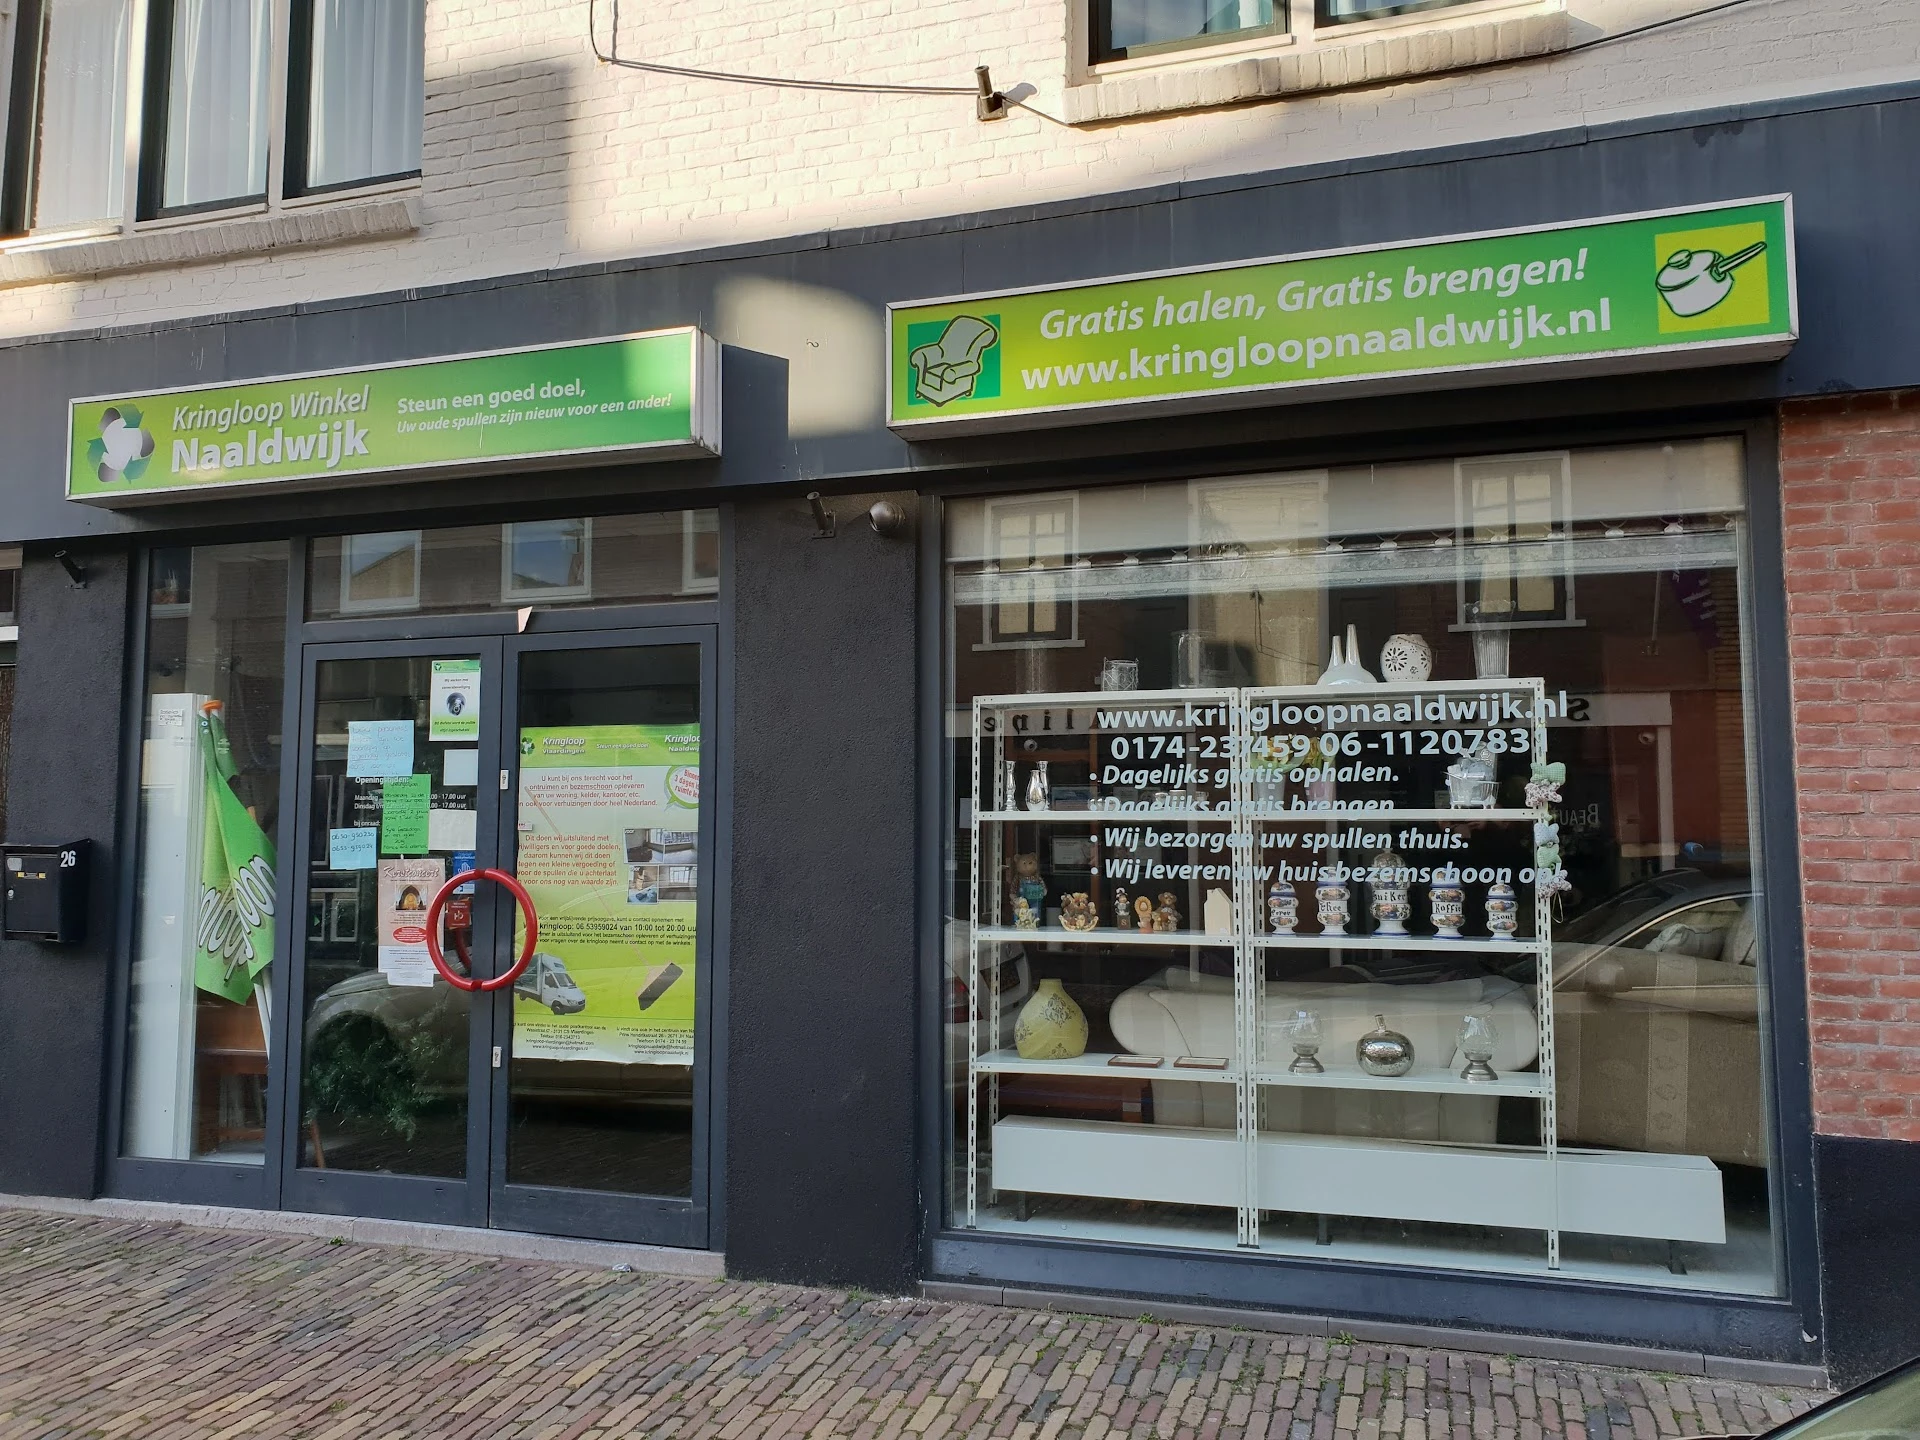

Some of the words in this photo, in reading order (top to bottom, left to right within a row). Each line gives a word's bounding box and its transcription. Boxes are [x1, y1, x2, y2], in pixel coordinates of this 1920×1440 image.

[1040, 300, 1144, 339] Gratis
[1152, 289, 1266, 327] halen,
[1277, 270, 1392, 312] Gratis
[1402, 247, 1588, 299] brengen!
[1021, 297, 1611, 390] www.kringloopnaaldwijk.nl
[397, 397, 447, 414] Steun
[452, 393, 484, 408] een
[488, 383, 535, 409] goed
[539, 378, 586, 399] doel,
[172, 399, 284, 433] Kringloop
[290, 384, 370, 418] Winkel
[397, 420, 417, 433] Uw
[418, 416, 450, 431] oude
[451, 412, 497, 431] spullen
[499, 409, 523, 427] zijn
[525, 406, 565, 421] nieuw
[567, 402, 598, 416] voor
[600, 401, 624, 413] een
[627, 393, 672, 411] ander!
[171, 419, 369, 473] Naaldwijk
[1097, 690, 1567, 731] www.kringloopnaaldwijk.nl
[542, 736, 585, 746] Kringloop
[1111, 733, 1310, 760] 0174-237459
[561, 774, 570, 783] bij
[1103, 764, 1209, 789] Dagelijks
[1214, 766, 1283, 789] gratis
[1289, 761, 1399, 786] ophalen.
[614, 782, 645, 790] opleveren
[554, 800, 592, 808] verhuizingen
[553, 835, 563, 843] wij
[576, 843, 596, 852] goede
[1105, 827, 1139, 853] Wij
[1144, 827, 1254, 853] bezorgen
[1260, 832, 1297, 849] uw
[1301, 827, 1392, 853] spullen
[1399, 828, 1469, 849] thuis.
[60, 850, 76, 868] 26
[551, 860, 571, 868] kleine
[572, 861, 607, 869] vergoeding
[574, 852, 584, 860] wij
[543, 869, 567, 877] spullen
[1105, 858, 1140, 884] Wij
[1145, 859, 1230, 880] leveren
[1234, 864, 1273, 881] uw
[553, 879, 566, 887] nog
[540, 923, 574, 931] kringloop:
[586, 923, 618, 931] 53959024
